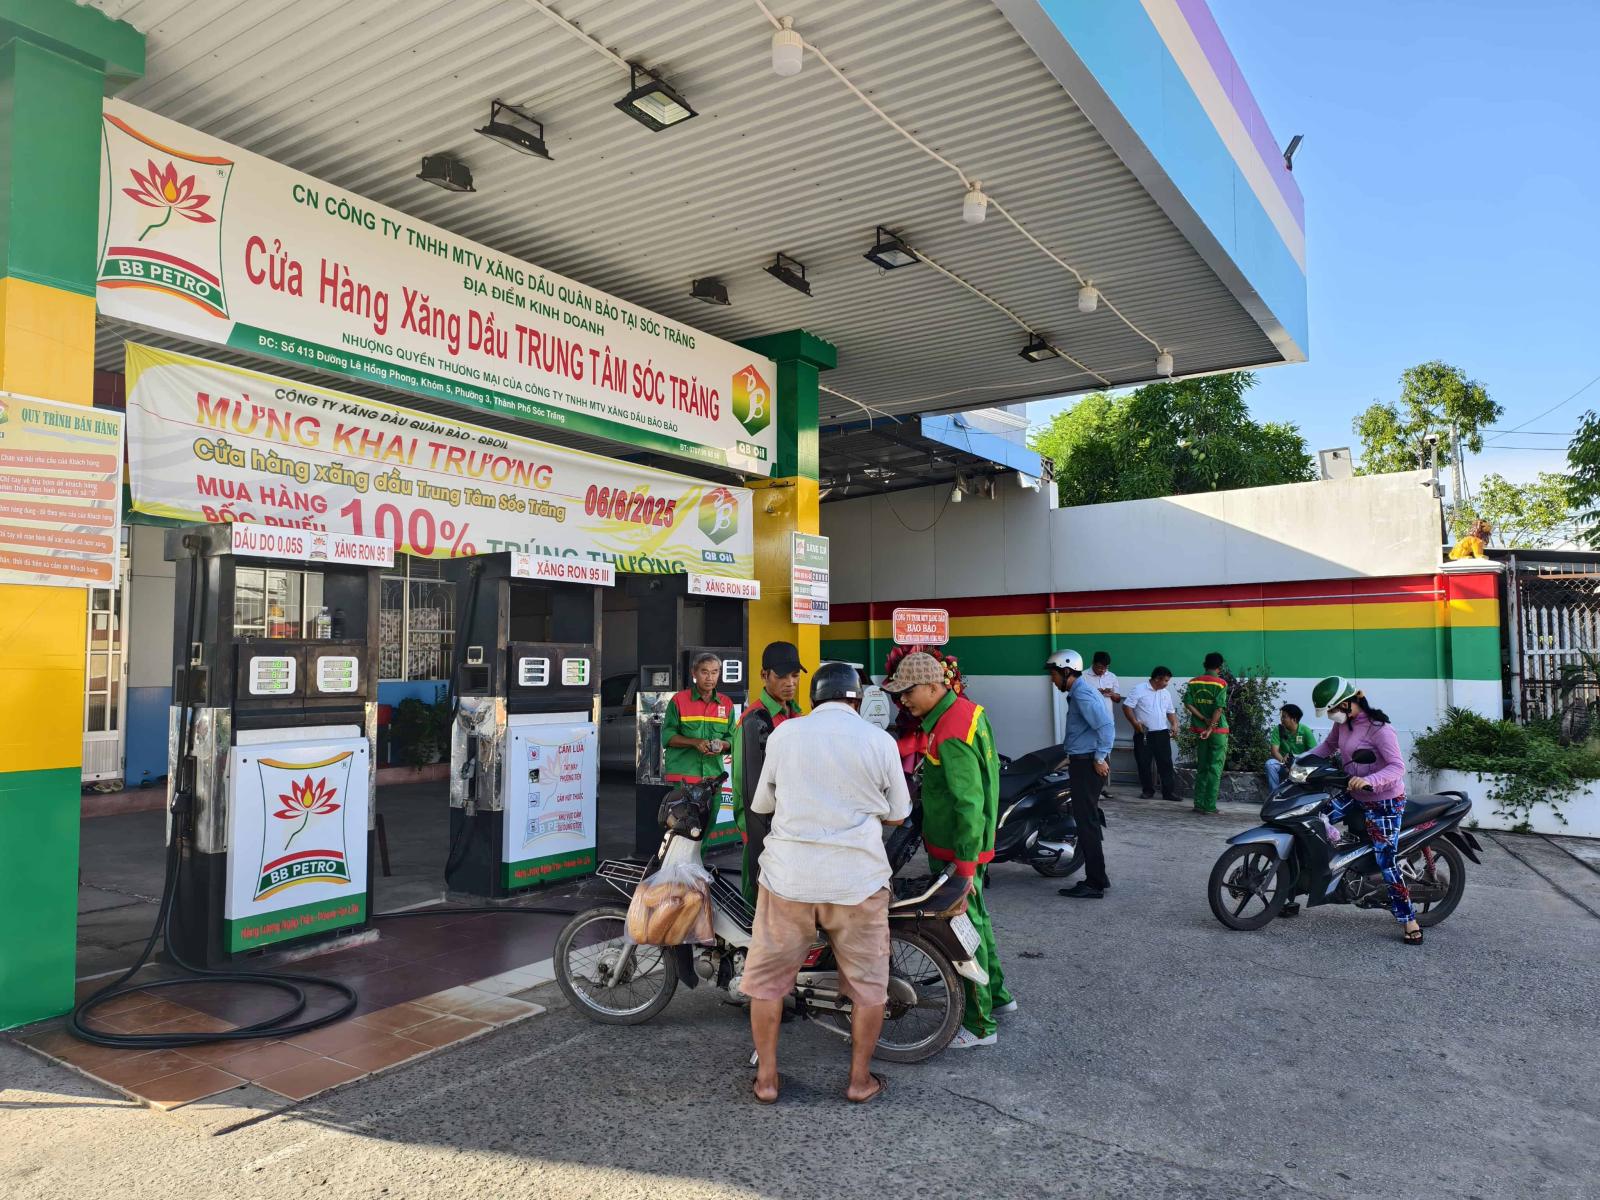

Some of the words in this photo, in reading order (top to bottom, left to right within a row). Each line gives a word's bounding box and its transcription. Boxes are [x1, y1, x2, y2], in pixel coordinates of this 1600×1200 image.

[118, 260, 145, 276] BB
[150, 264, 210, 297] PETRO
[293, 184, 318, 210] CN
[326, 198, 376, 230] CÔNG
[382, 218, 402, 240] TY
[407, 228, 448, 258] TNHH
[453, 246, 482, 271] MTV
[558, 286, 592, 311] QUÂN
[621, 310, 638, 331] TẠI
[640, 316, 660, 337] SÓC
[663, 326, 696, 350] TRĂNG
[464, 276, 488, 296] ĐỊA
[492, 287, 526, 309] ĐIỂM
[530, 301, 560, 321] KINH
[563, 312, 604, 336] DOANH
[245, 236, 303, 297] Cửa
[320, 258, 388, 335] Hàng
[400, 286, 460, 356] Xăng
[468, 309, 508, 360] Dầu
[515, 324, 584, 381] TRUNG
[589, 345, 627, 394] TÂM
[632, 360, 664, 405] SÓC
[670, 375, 720, 421] TRĂNG
[258, 336, 278, 349] ĐC:
[281, 340, 295, 353] Số
[296, 344, 314, 359] 413
[316, 350, 348, 368] Đường
[350, 358, 362, 370] Lê
[364, 362, 387, 380] Hồng
[389, 369, 419, 387] Phong,
[421, 378, 444, 392] Khóm
[455, 386, 484, 402] Phường
[493, 396, 516, 410] Thành
[518, 400, 531, 413] Phố
[532, 406, 546, 417] Sóc
[547, 410, 566, 423] Trăng
[342, 332, 392, 357] NHƯỢNG
[438, 359, 480, 380] THƯƠNG
[483, 372, 500, 386] MẠI
[524, 383, 550, 398] CÔNG
[552, 390, 564, 400] TY
[566, 394, 588, 408] TNHH
[589, 400, 606, 412] MTV
[22, 408, 40, 424] QUY
[43, 410, 72, 429] TRÌNH
[74, 416, 92, 432] BÁN
[94, 418, 118, 436] HÀNG
[274, 388, 318, 406] CÔNG
[322, 399, 338, 411] TY
[340, 403, 380, 420] XĂNG
[380, 410, 408, 427] DẦU
[409, 420, 446, 436] QUÂN
[196, 391, 321, 448] MỪNG
[333, 423, 418, 466] KHAI
[428, 441, 553, 490] TRƯƠNG
[739, 442, 750, 454] QB
[192, 436, 246, 468] Cửa
[251, 447, 310, 485] hàng
[314, 462, 370, 493] xăng
[374, 468, 412, 496] dầu
[417, 480, 461, 507] Trung
[464, 487, 496, 509] Tâm
[498, 493, 526, 513] Sóc
[528, 498, 566, 523] Trăng
[196, 475, 252, 502] MUA
[259, 485, 328, 514] HÀNG
[584, 484, 677, 528] 06/6/2025
[260, 534, 274, 551] DO
[278, 536, 303, 556] 0,05S
[341, 498, 477, 558] 100%
[358, 544, 376, 561] RON
[376, 546, 386, 562] 95
[567, 565, 588, 580] RON
[590, 568, 600, 581] 95
[704, 552, 716, 561] QB
[719, 553, 732, 563] Oil
[726, 582, 742, 595] RON
[270, 868, 288, 884] BB
[293, 860, 336, 876] PETRO
